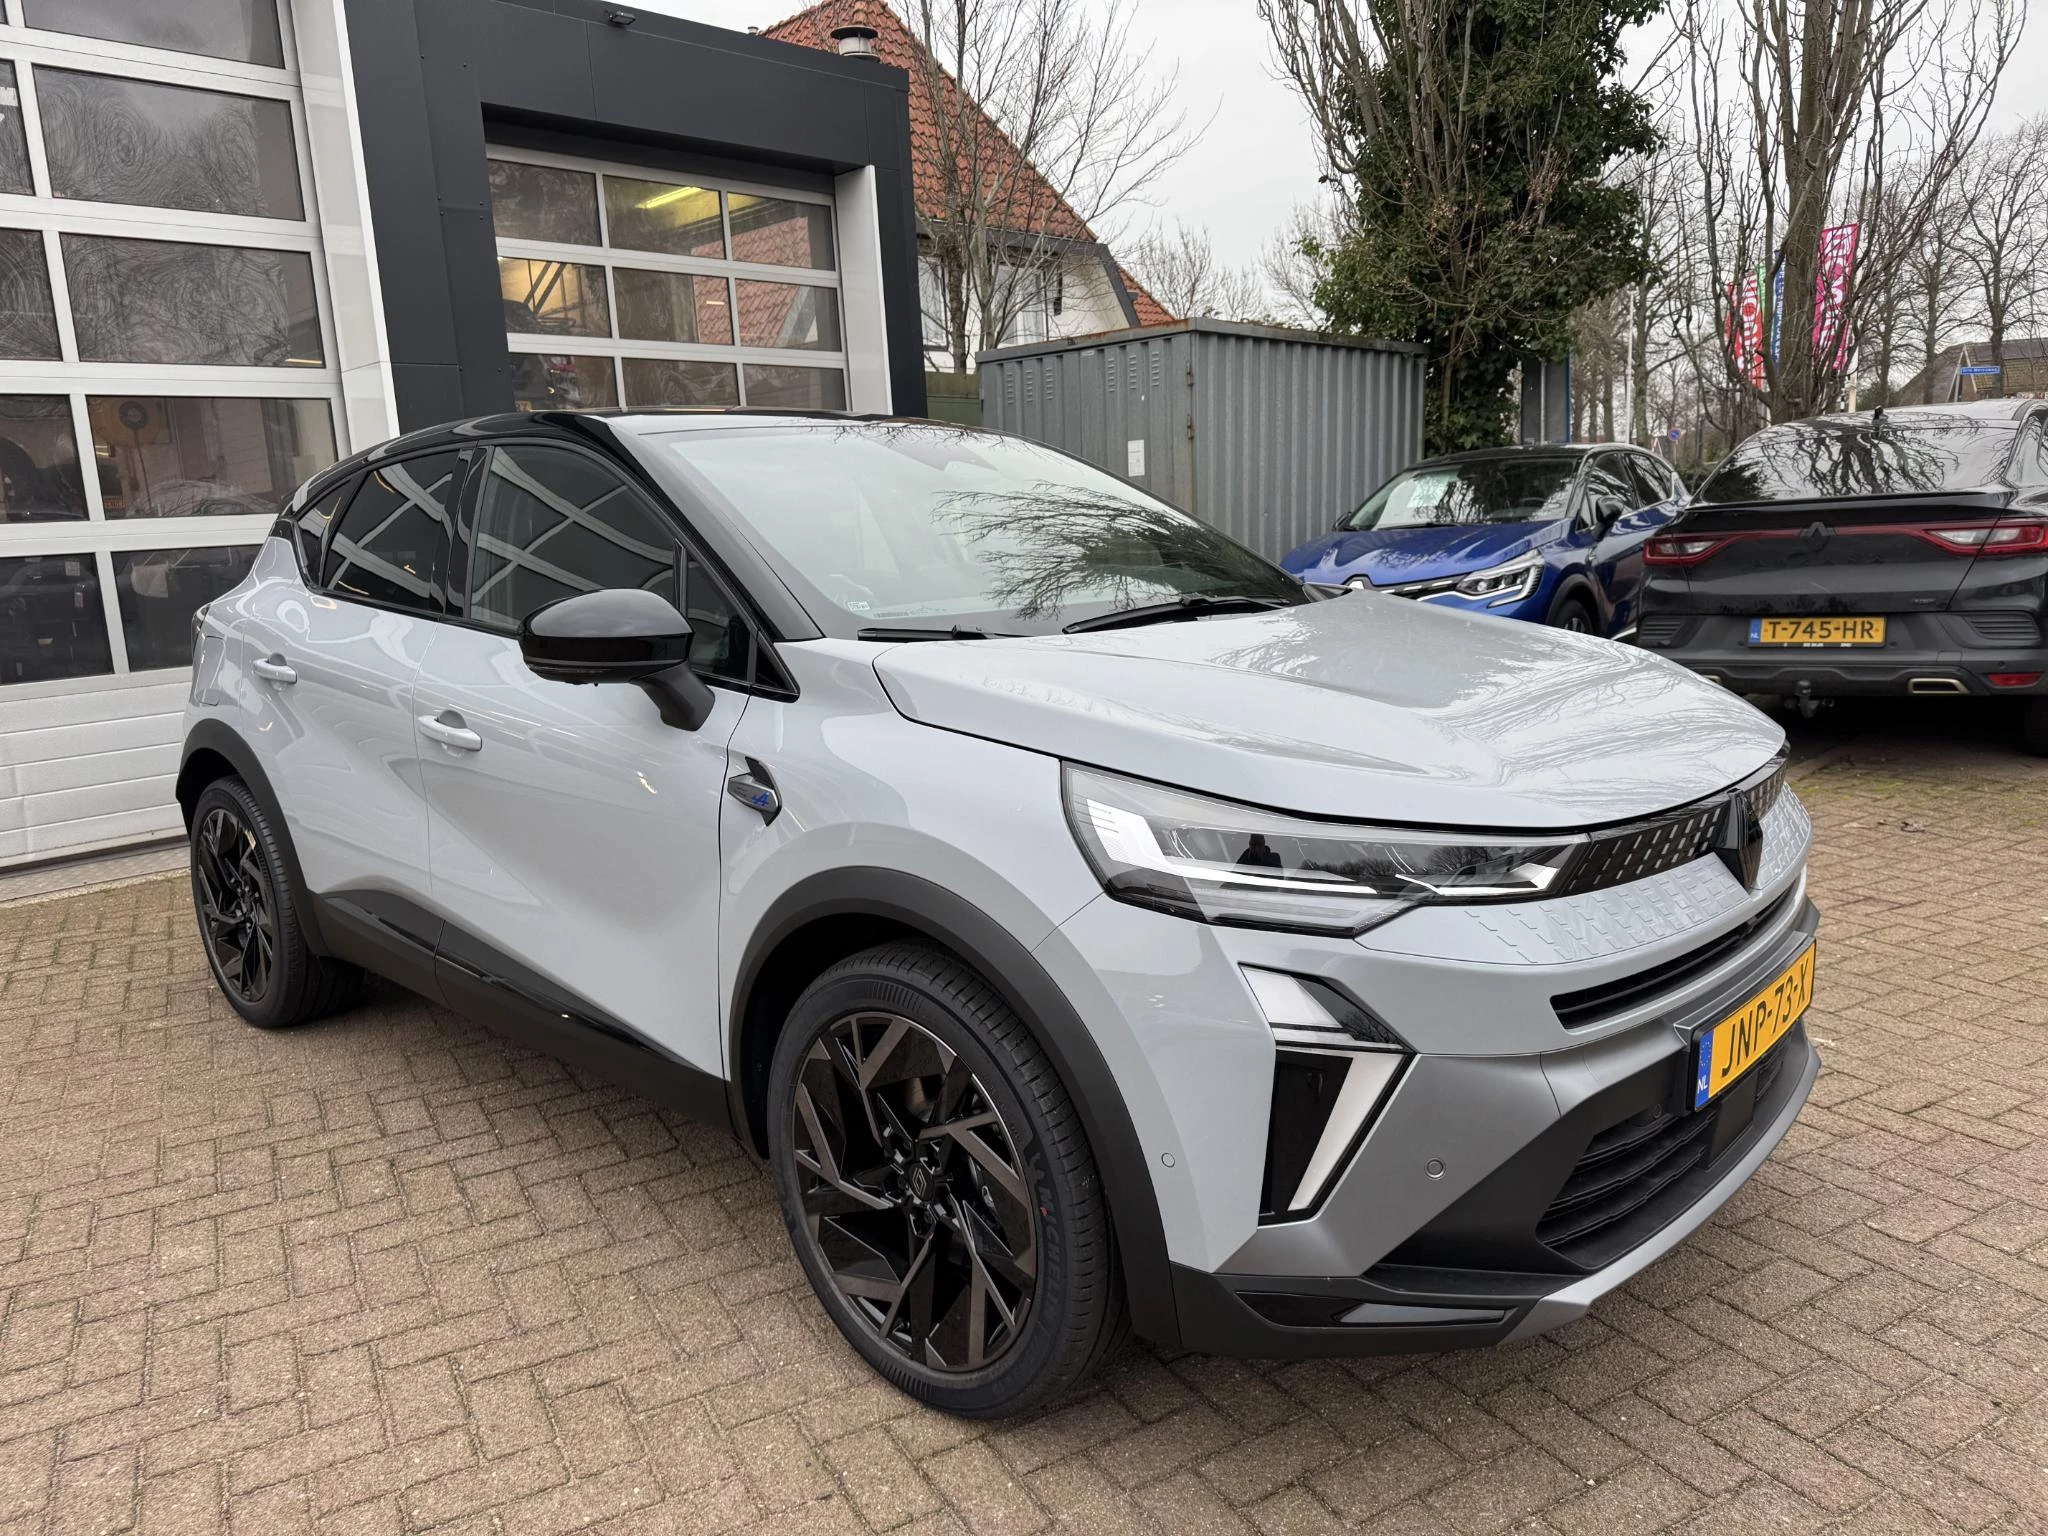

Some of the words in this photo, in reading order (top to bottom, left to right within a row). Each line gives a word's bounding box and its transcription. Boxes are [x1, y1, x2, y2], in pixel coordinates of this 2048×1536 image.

[1768, 620, 1874, 639] T-745-HR
[1721, 957, 1810, 1078] JNP-73-X
[1697, 1074, 1709, 1095] NL
[1039, 1187, 1062, 1321] MICHELIN
